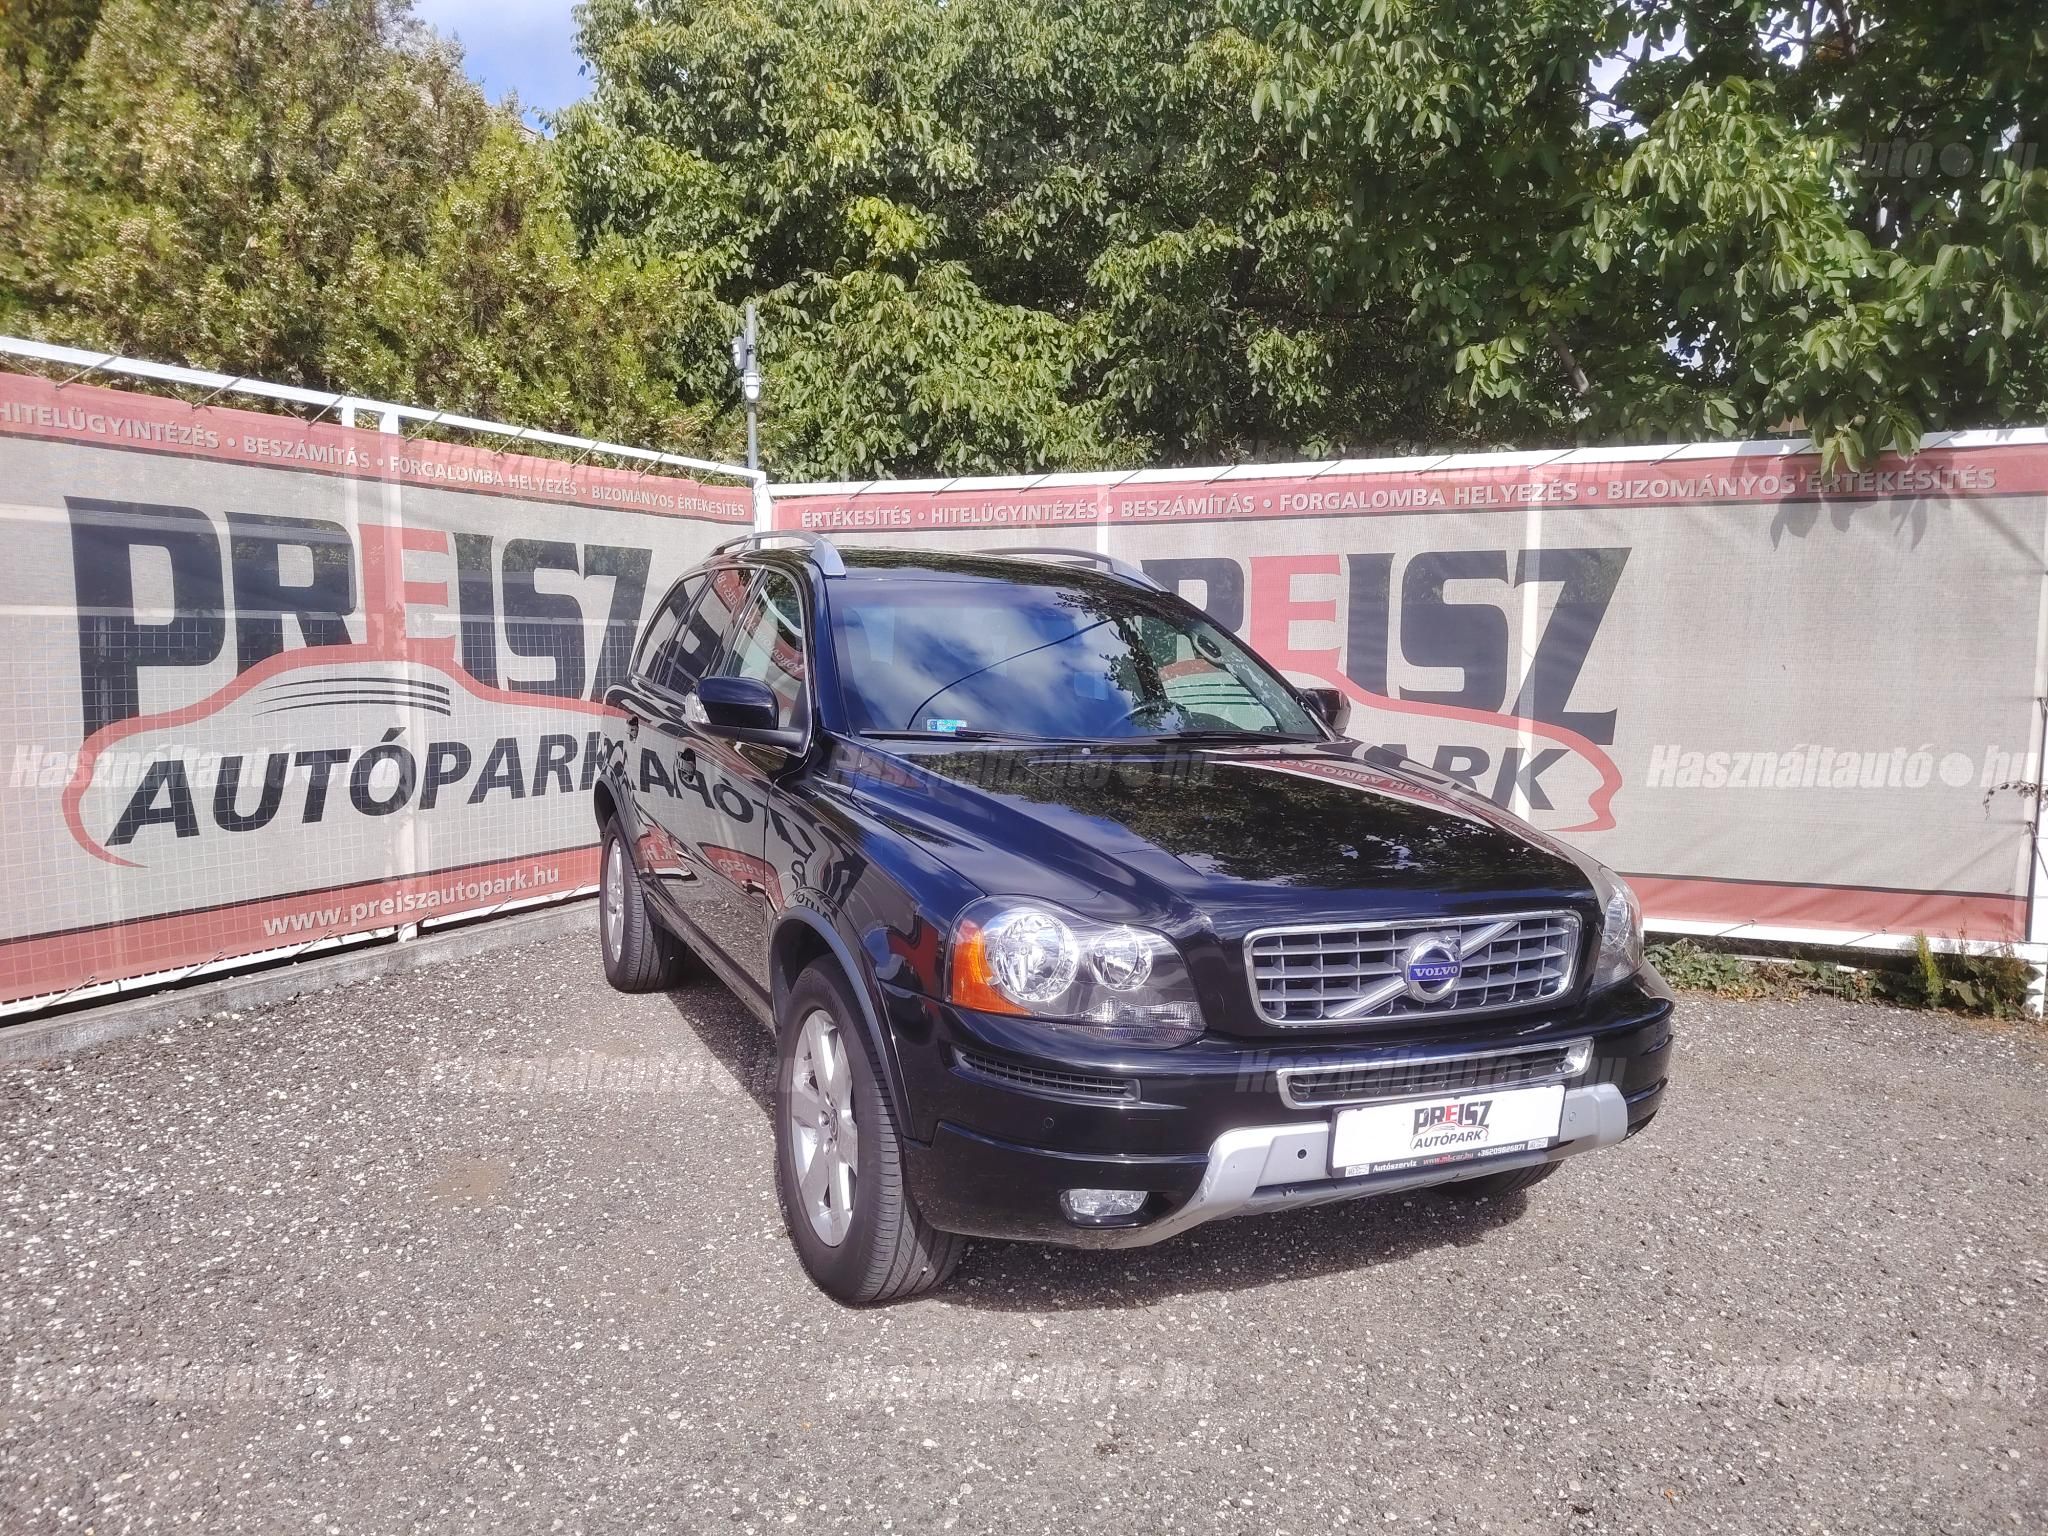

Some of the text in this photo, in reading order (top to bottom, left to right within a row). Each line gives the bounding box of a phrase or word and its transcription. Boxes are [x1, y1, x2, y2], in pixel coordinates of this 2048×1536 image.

[243, 434, 370, 469] BESZÁMÍTÁS
[390, 455, 504, 487] FORGALOMBA
[508, 475, 578, 497] HELYEZÉS
[591, 485, 675, 510] BIZOMÁNYOS
[678, 493, 745, 517] ÉRTÉKESÍTÉS
[801, 504, 912, 528] ÉRTÉKESÍTÉS
[931, 499, 1098, 524] HITELÜGYINTÉZÉS
[1120, 493, 1256, 518] BESZÁMÍTÁS
[1279, 487, 1447, 512] FORGALOMBA
[1454, 479, 1578, 506] HELYEZÉS
[1607, 474, 1797, 500] BIZOMÁNYOS
[63, 495, 653, 743] PREISZ
[1140, 547, 1632, 745] REISZ
[262, 865, 560, 937] www.preiszautopark.hu
[1413, 966, 1459, 977] VOLVO
[1413, 1100, 1493, 1136] PREISZ
[1414, 1130, 1483, 1149] AUTÓPARK
[1373, 1159, 1417, 1173] Autószerviz
